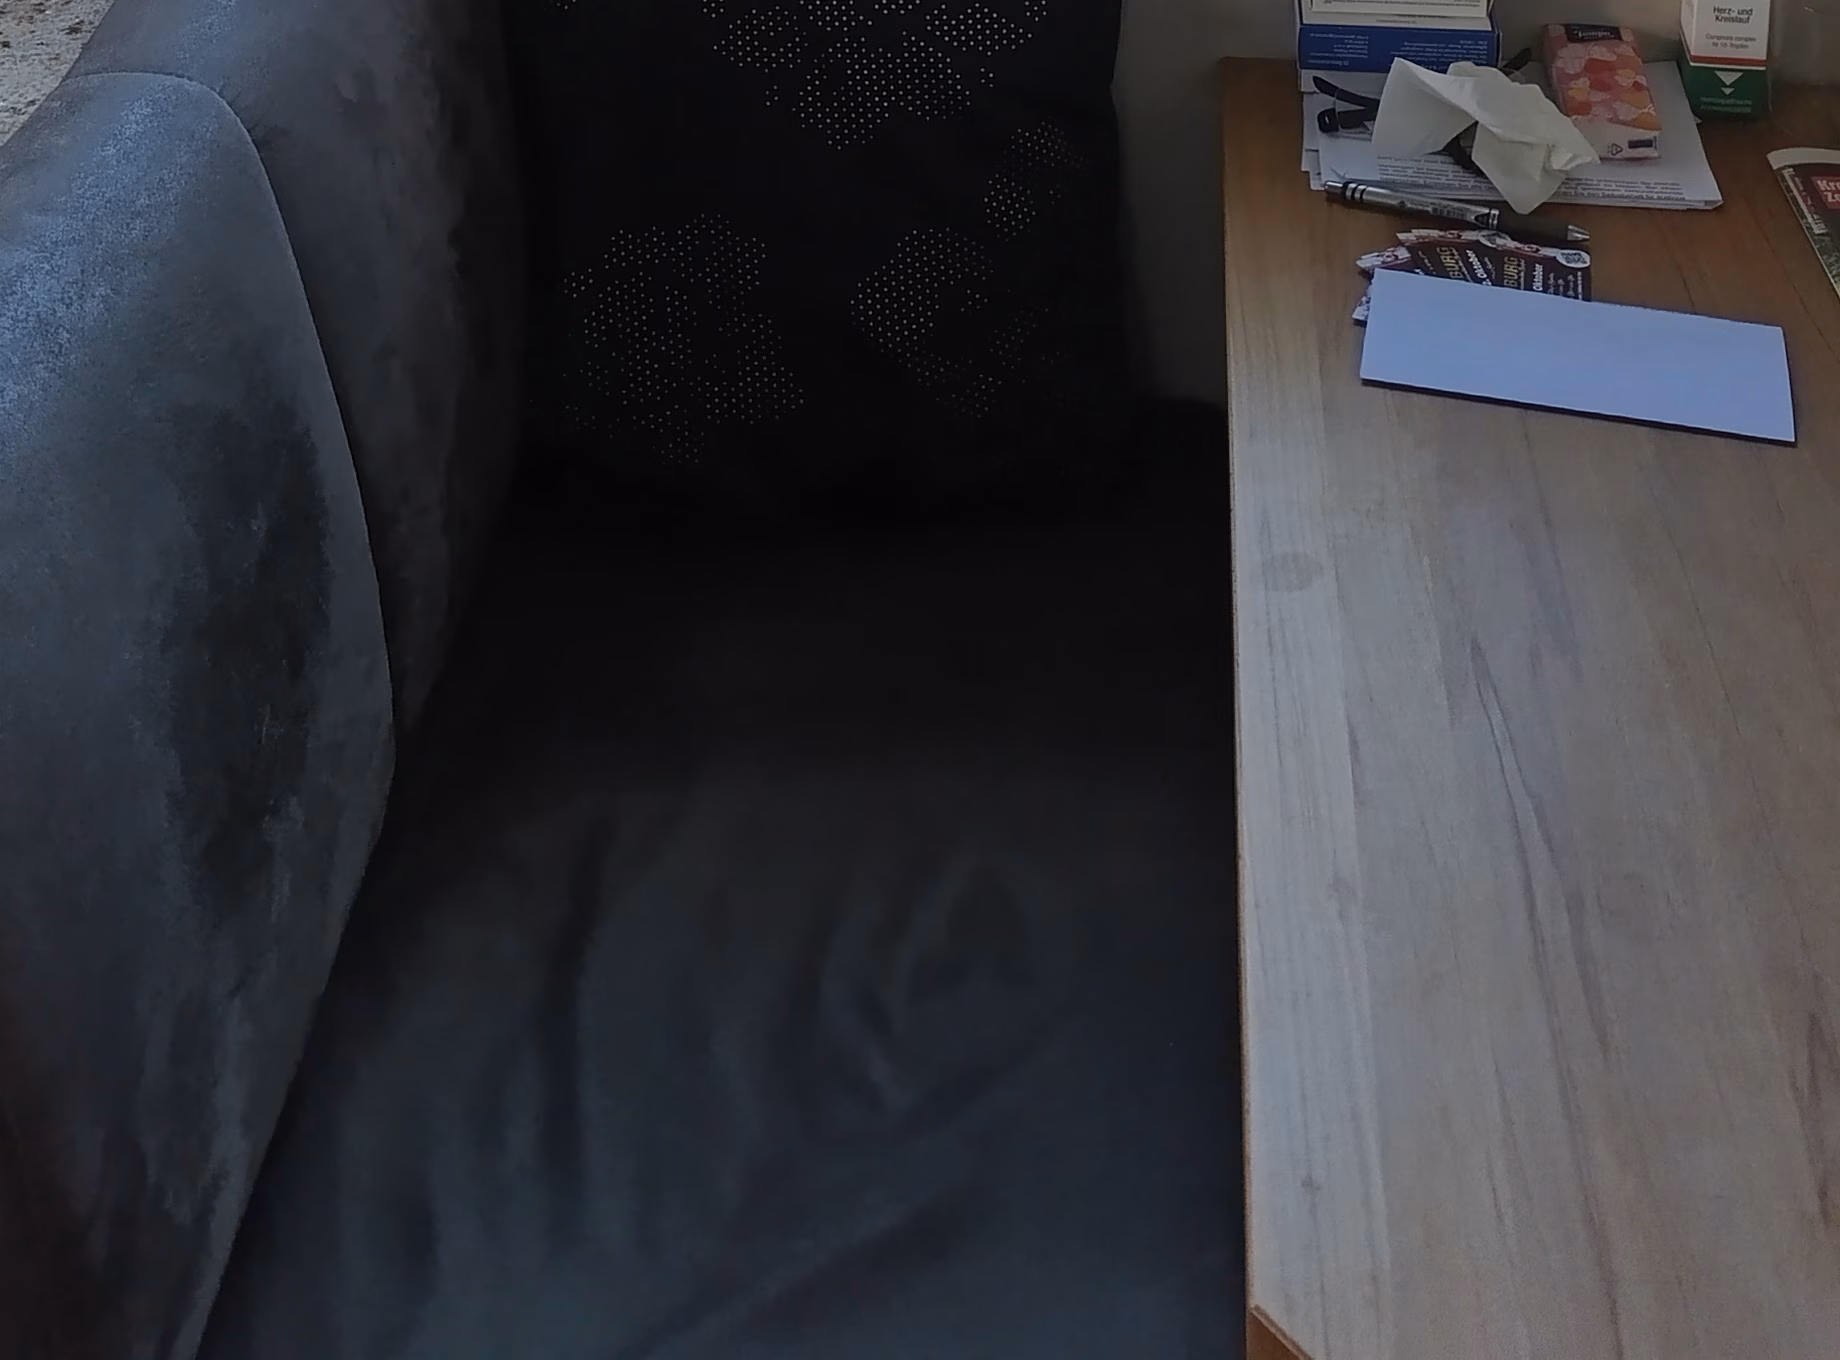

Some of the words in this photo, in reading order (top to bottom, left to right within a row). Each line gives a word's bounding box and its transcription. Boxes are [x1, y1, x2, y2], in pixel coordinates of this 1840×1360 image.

[1713, 5, 1735, 15] Herz-
[1737, 7, 1753, 16] und
[1715, 14, 1751, 24] Kreislauf
[1465, 249, 1488, 278] Oktober
[1503, 256, 1518, 287] BURG
[1532, 262, 1543, 291] Oktober
